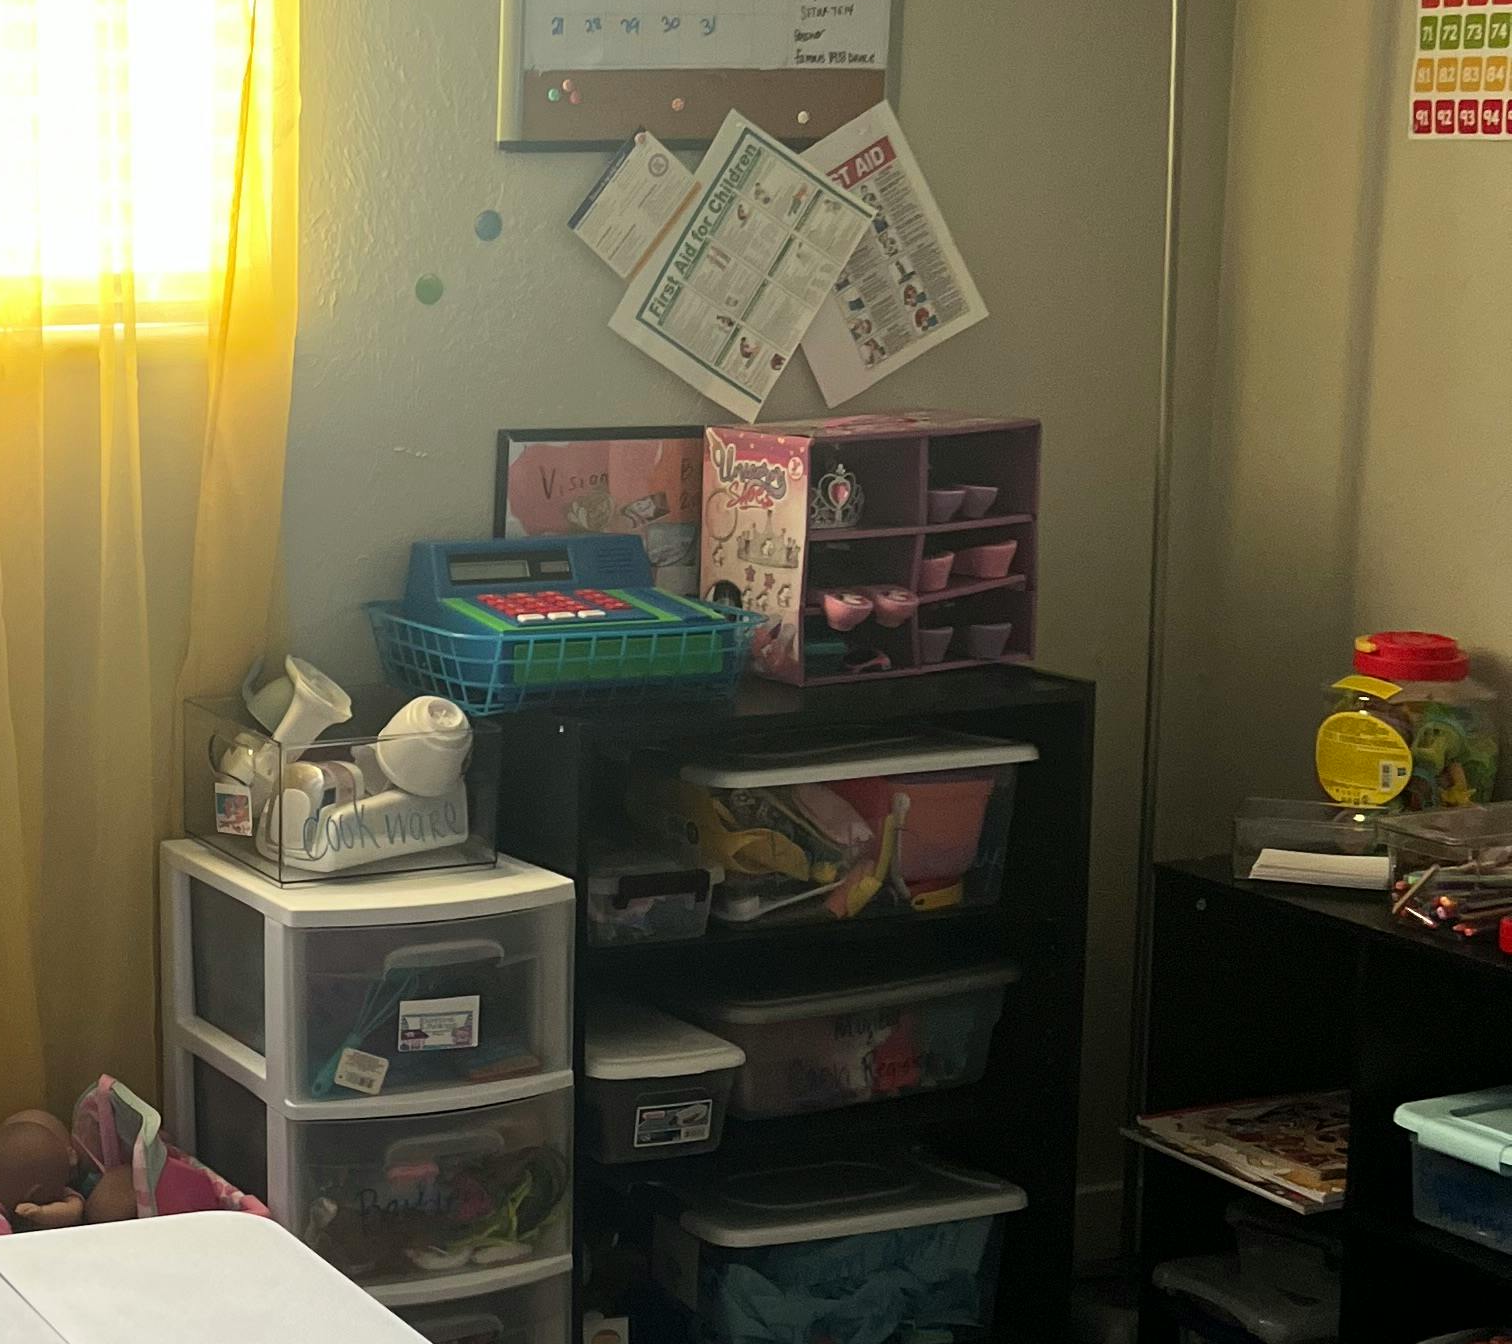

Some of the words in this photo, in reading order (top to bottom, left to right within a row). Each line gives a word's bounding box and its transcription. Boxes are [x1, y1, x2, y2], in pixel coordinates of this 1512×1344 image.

[584, 17, 602, 33] 28
[620, 17, 641, 34] 29
[661, 15, 681, 33] 30
[700, 15, 716, 36] 31
[1422, 25, 1434, 42] 71
[1441, 24, 1458, 42] 72
[1466, 23, 1483, 40] 73
[1490, 22, 1508, 40] 74
[1486, 65, 1505, 82] 84
[1415, 109, 1430, 126] 91
[1437, 109, 1452, 126] 92
[1460, 109, 1475, 126] 93
[1483, 109, 1500, 126] 94
[854, 146, 885, 177] AID
[648, 275, 680, 318] First
[673, 241, 700, 276] Aid
[691, 214, 715, 244] for
[708, 143, 757, 215] Children
[539, 466, 609, 500] Vision
